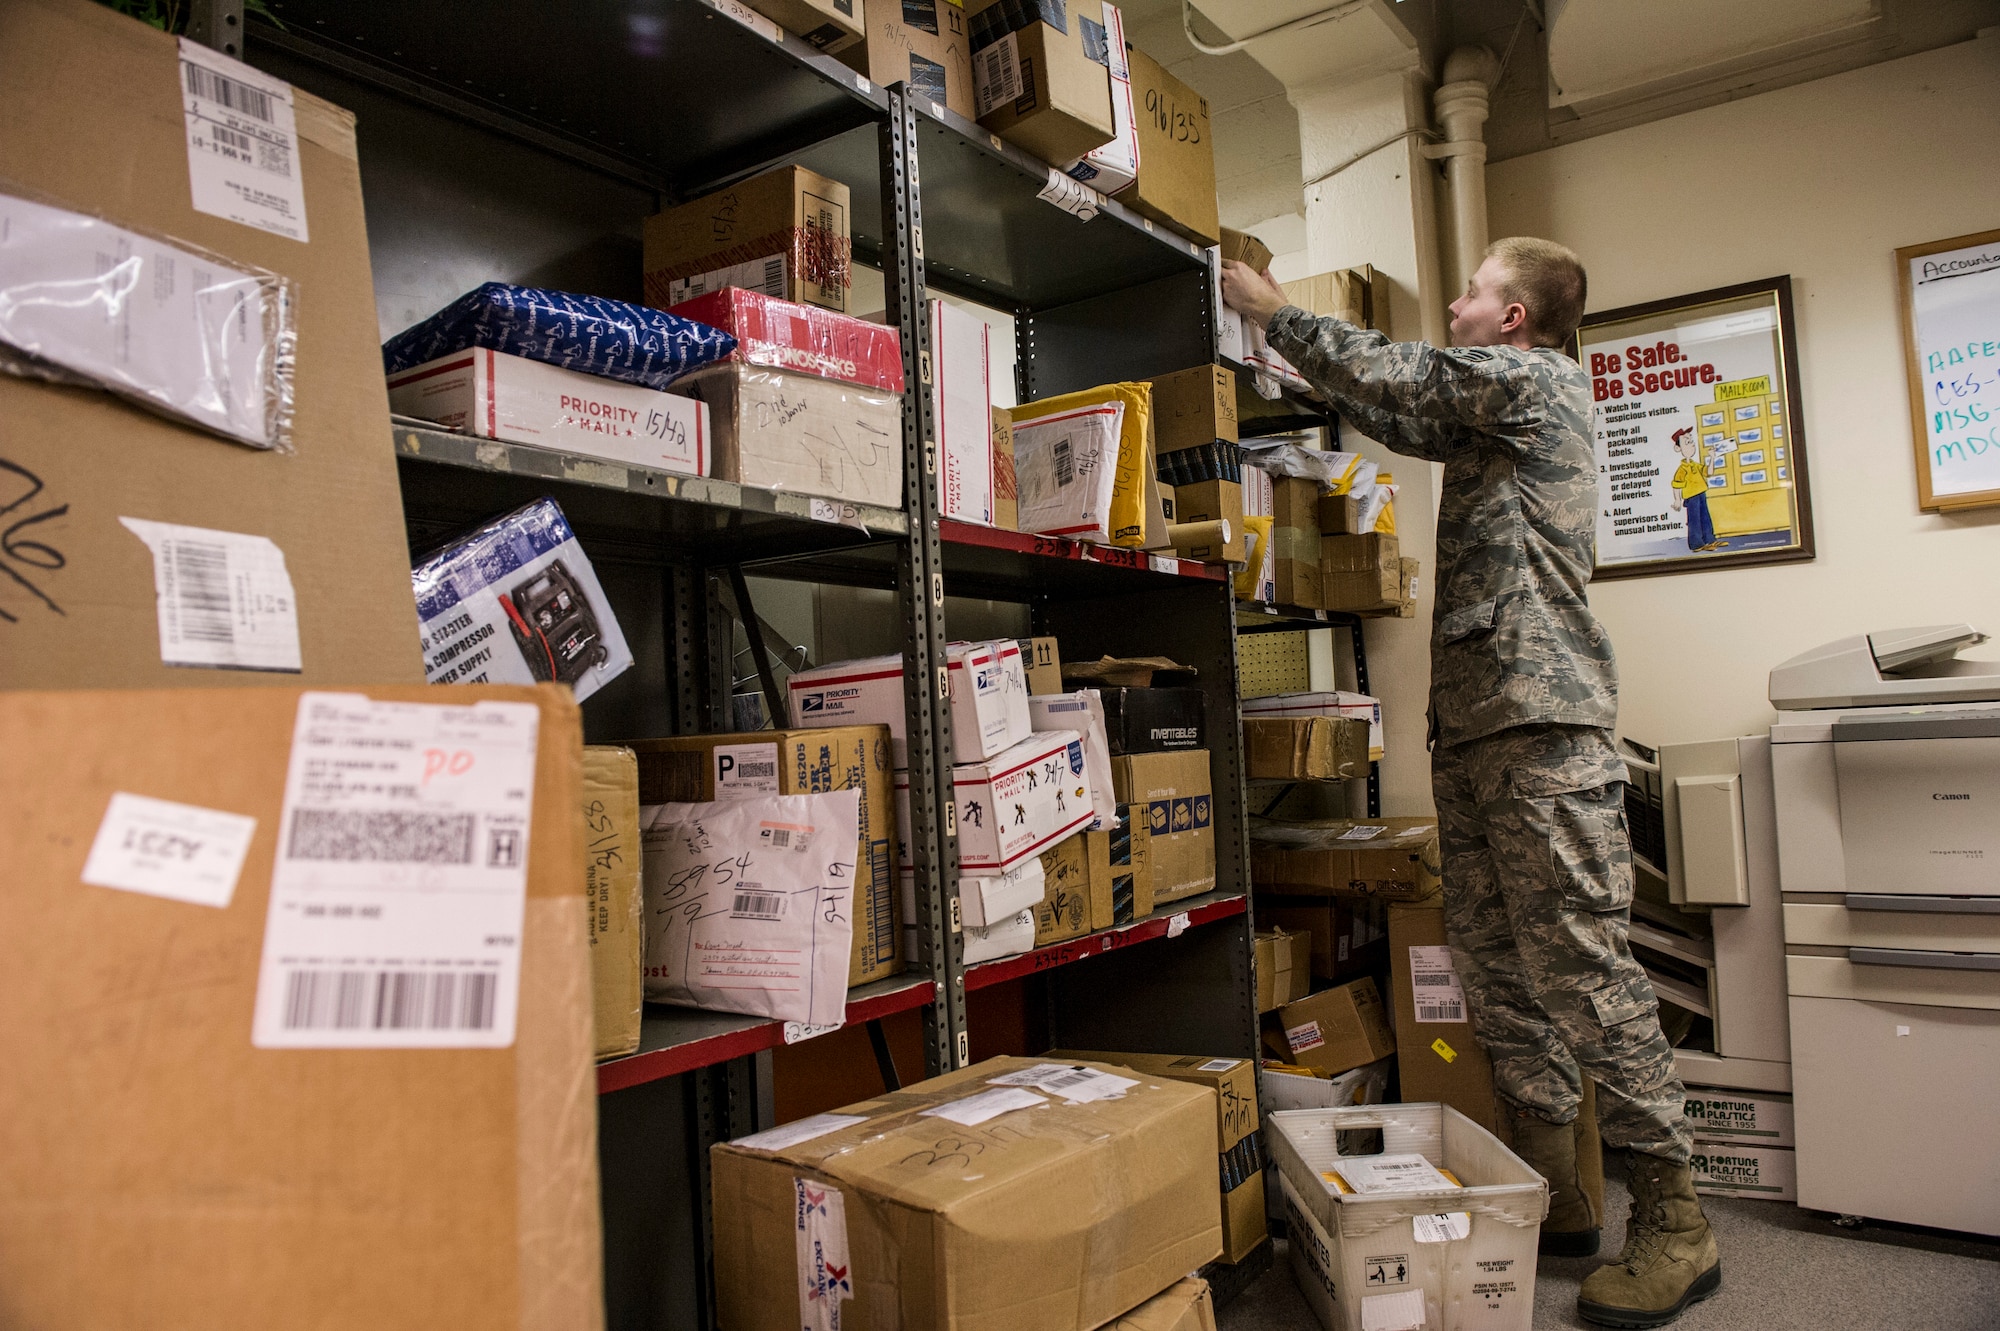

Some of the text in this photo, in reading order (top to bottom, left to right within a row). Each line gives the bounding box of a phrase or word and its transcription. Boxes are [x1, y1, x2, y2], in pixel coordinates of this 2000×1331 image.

[1146, 89, 1200, 144] 96/35
[1591, 341, 1688, 377] Be Safe.
[1593, 363, 1722, 402] Be Secure.
[560, 394, 640, 426] PRIORITY
[1605, 405, 1629, 414] Watch
[1605, 405, 1680, 424] suspicious visitors.
[580, 415, 620, 437] MAIL
[1607, 428, 1629, 439] Verify
[1630, 426, 1640, 434] all
[1607, 436, 1648, 448] packaging
[1608, 447, 1635, 458] labels.
[1600, 459, 1652, 473] 3. Investigate
[1610, 467, 1660, 481] unscheduled
[1611, 479, 1652, 492] or delayed
[1612, 490, 1653, 502] deliveries.
[815, 501, 856, 520] 2315
[1613, 507, 1632, 516] Alert
[1613, 512, 1668, 527] supervisors of
[1116, 527, 1139, 538] Scotch
[1614, 521, 1684, 536] unusual behavior.
[433, 623, 495, 669] COMPRESSOR
[459, 647, 494, 676] SUPPLY
[826, 688, 859, 699] PRIORITY
[826, 702, 845, 711] MAIL
[719, 755, 734, 781] P
[797, 743, 808, 789] 26205
[995, 771, 1025, 792] PRIORITY
[1004, 788, 1021, 800] MAIL
[587, 864, 596, 898] CHINA
[599, 876, 609, 932] KEEP DRY!
[1706, 1101, 1755, 1111] FORTUNE
[1707, 1111, 1756, 1121] PLASTICS
[1708, 1120, 1756, 1129] SINCE 1955
[1710, 1156, 1758, 1166] FORTUNE
[1710, 1166, 1759, 1176] PLASTICS
[1710, 1174, 1735, 1183] SINCE
[1305, 1228, 1331, 1269] STATES
